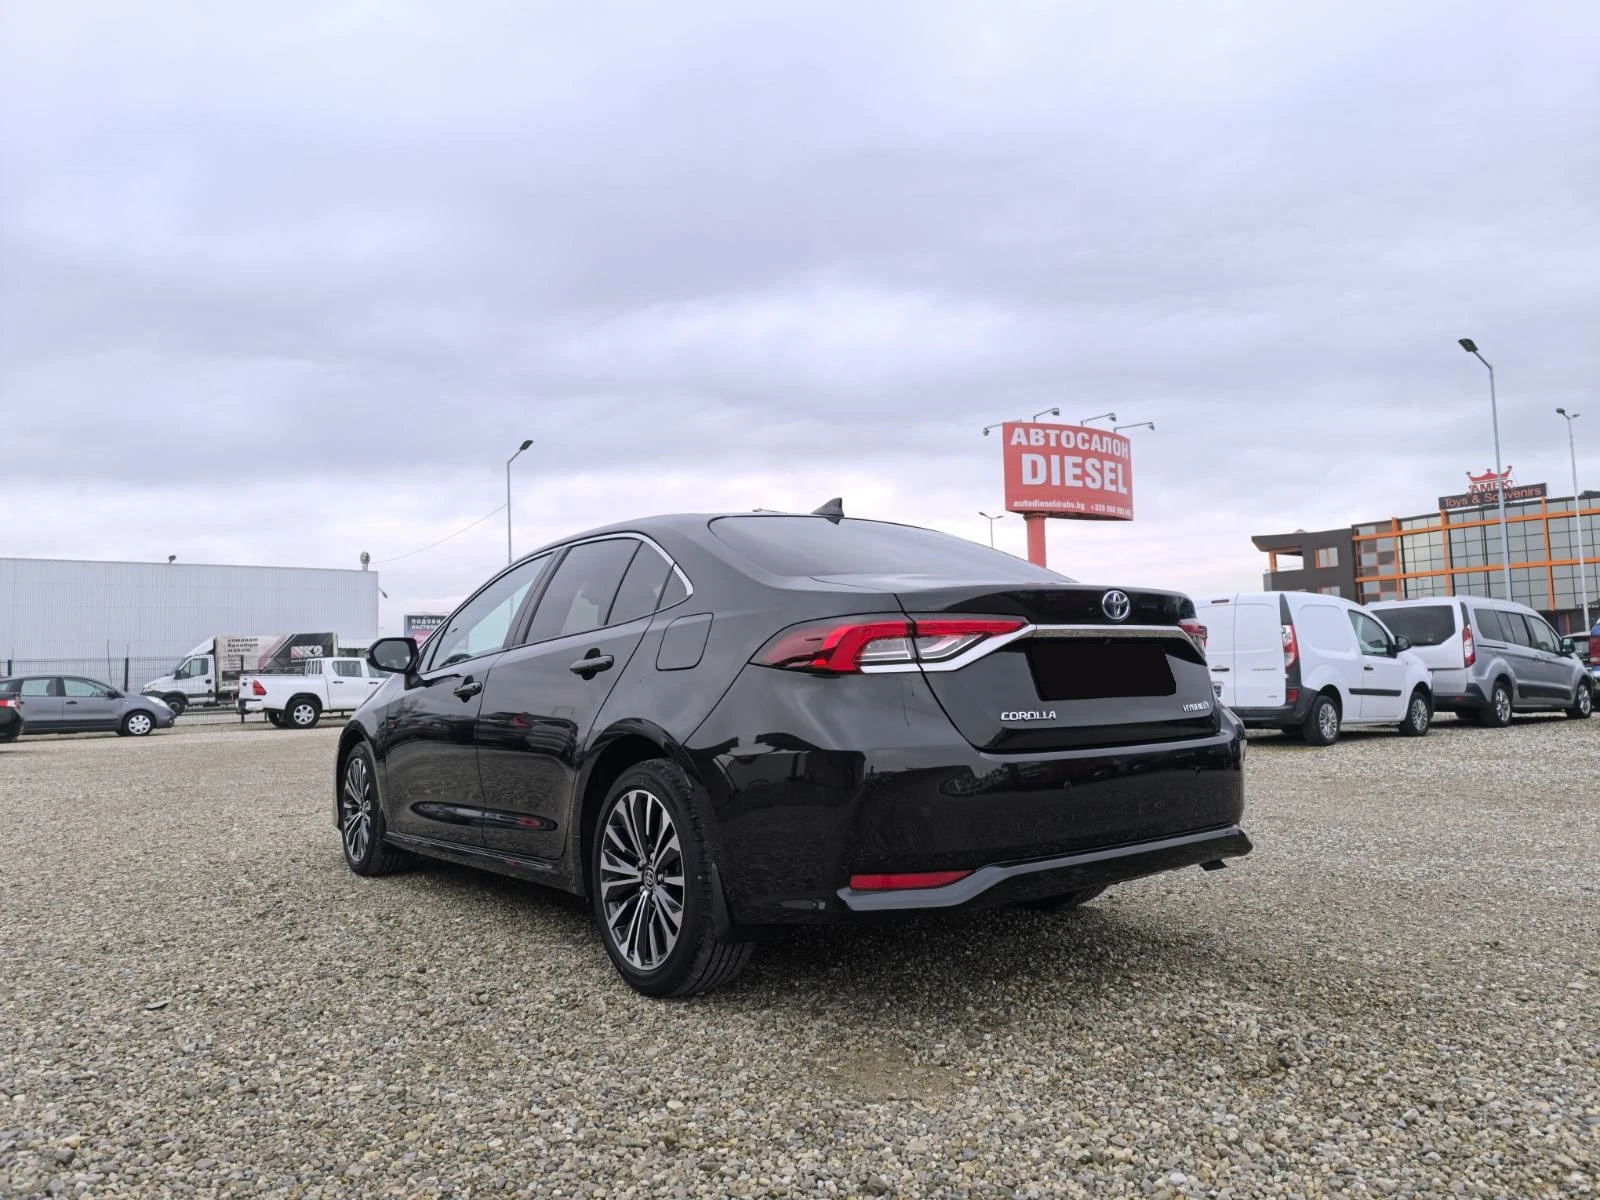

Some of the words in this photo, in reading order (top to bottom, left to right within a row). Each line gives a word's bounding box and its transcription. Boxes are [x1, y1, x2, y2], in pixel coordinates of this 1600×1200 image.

[1010, 427, 1129, 460] АВТОСАЛОН
[1021, 453, 1128, 495] DIESEL
[1444, 497, 1469, 508] Toys
[1471, 494, 1480, 504] &
[1000, 711, 1057, 720] COROLLA
